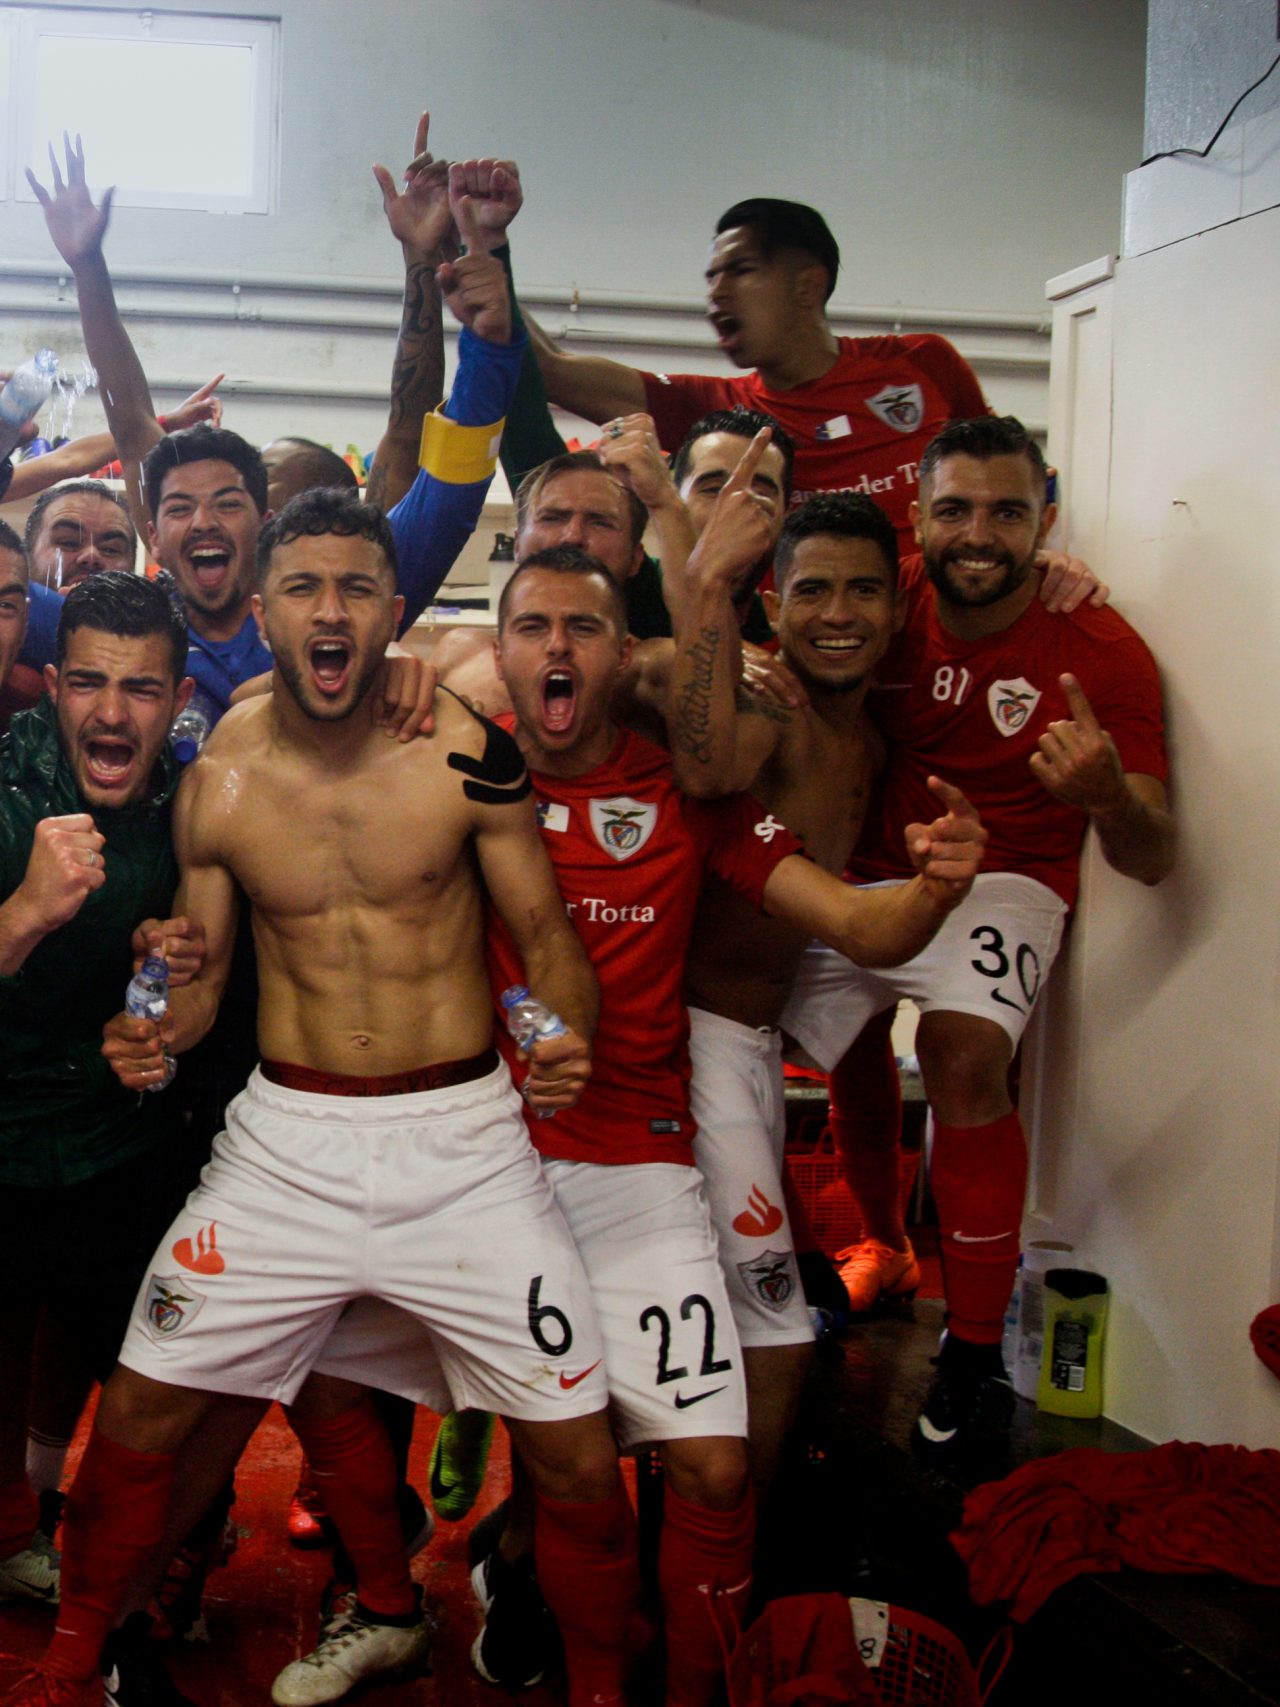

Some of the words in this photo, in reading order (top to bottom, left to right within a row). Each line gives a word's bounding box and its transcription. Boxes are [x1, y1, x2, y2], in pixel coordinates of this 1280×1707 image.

[932, 665, 969, 705] 81
[582, 898, 655, 923] Totta
[969, 925, 1041, 1006] 30
[528, 1275, 573, 1356] 6
[639, 1293, 733, 1385] 22
